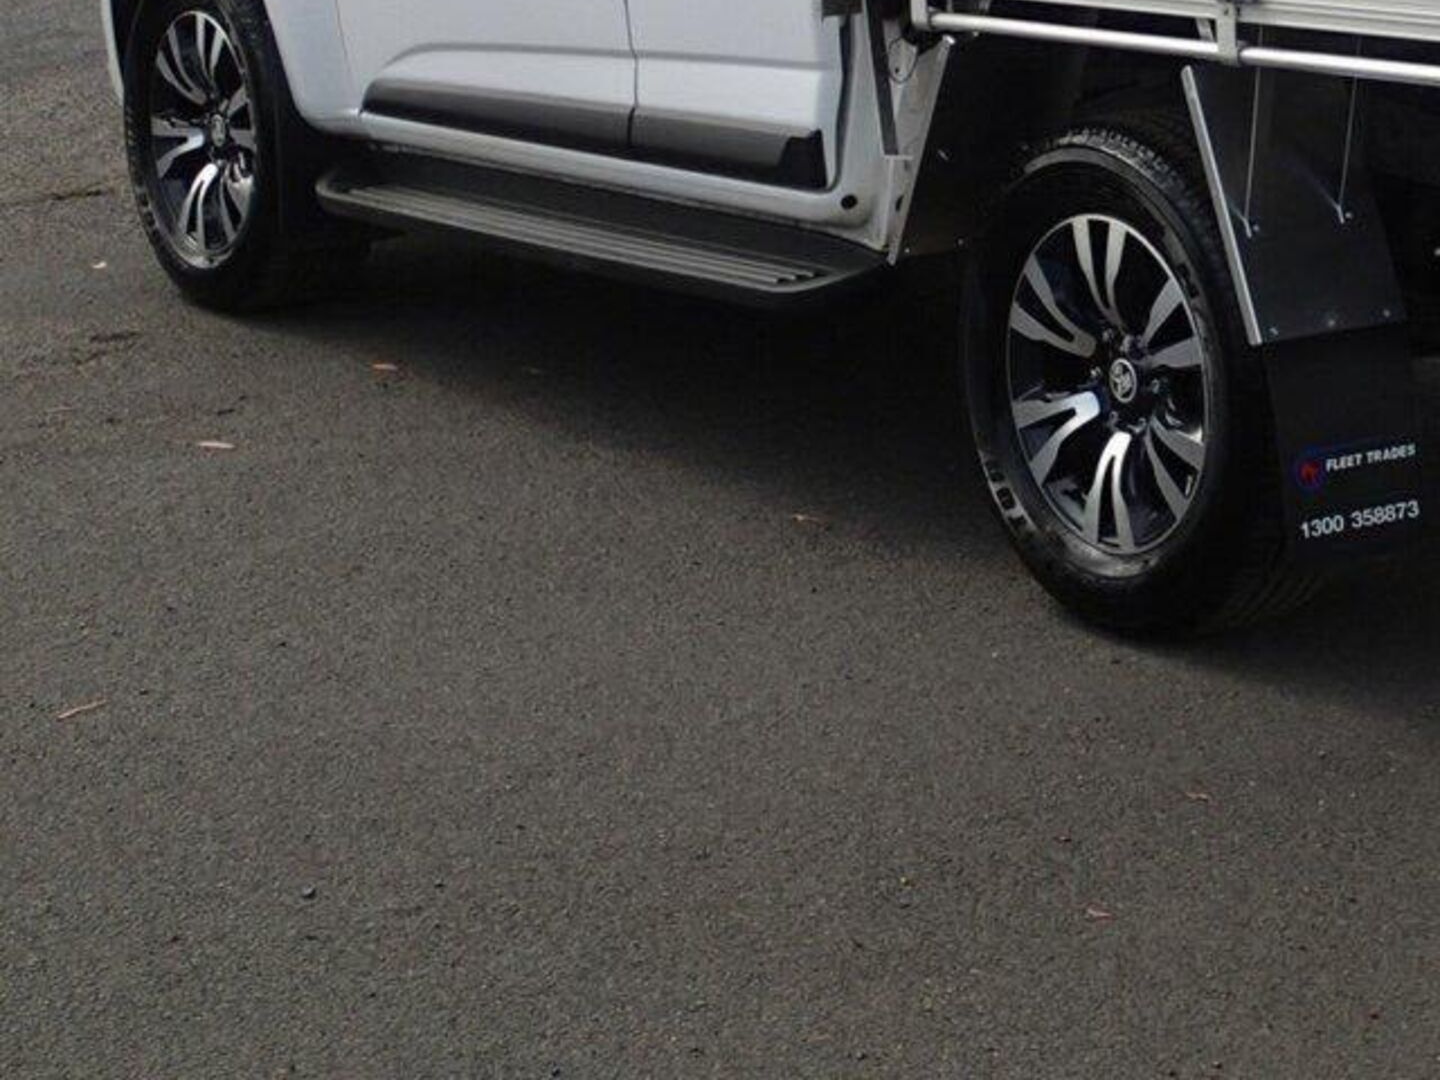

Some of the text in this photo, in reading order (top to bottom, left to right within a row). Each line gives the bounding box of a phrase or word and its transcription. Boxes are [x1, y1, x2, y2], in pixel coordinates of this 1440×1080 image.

[1325, 443, 1417, 472] FLEET TRADES
[1300, 499, 1421, 539] 1300 358873
